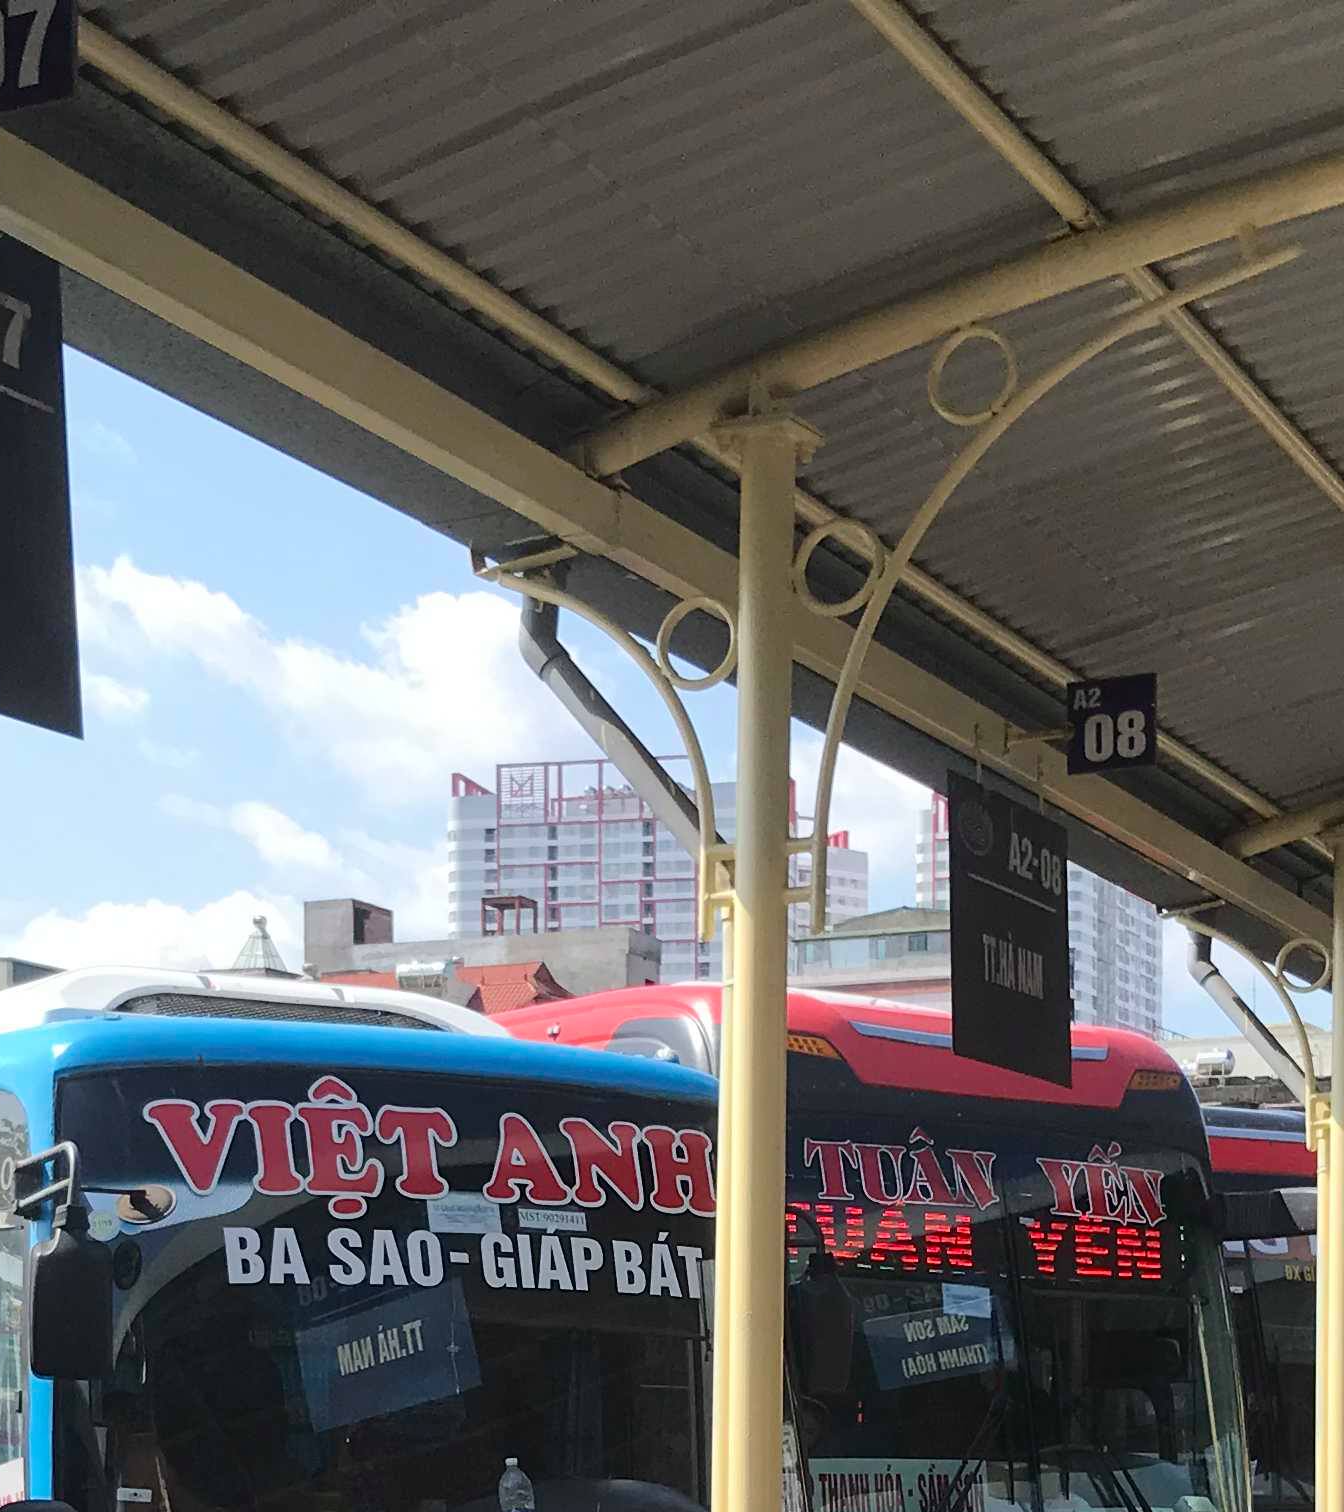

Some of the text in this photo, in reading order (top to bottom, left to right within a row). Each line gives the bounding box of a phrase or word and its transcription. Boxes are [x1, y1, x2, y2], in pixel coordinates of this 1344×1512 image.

[1073, 688, 1102, 711] A2
[1084, 710, 1147, 762] 08
[144, 1075, 718, 1220] VIỆT ANH
[225, 1227, 310, 1286] BA
[613, 1231, 703, 1300] BÁT
